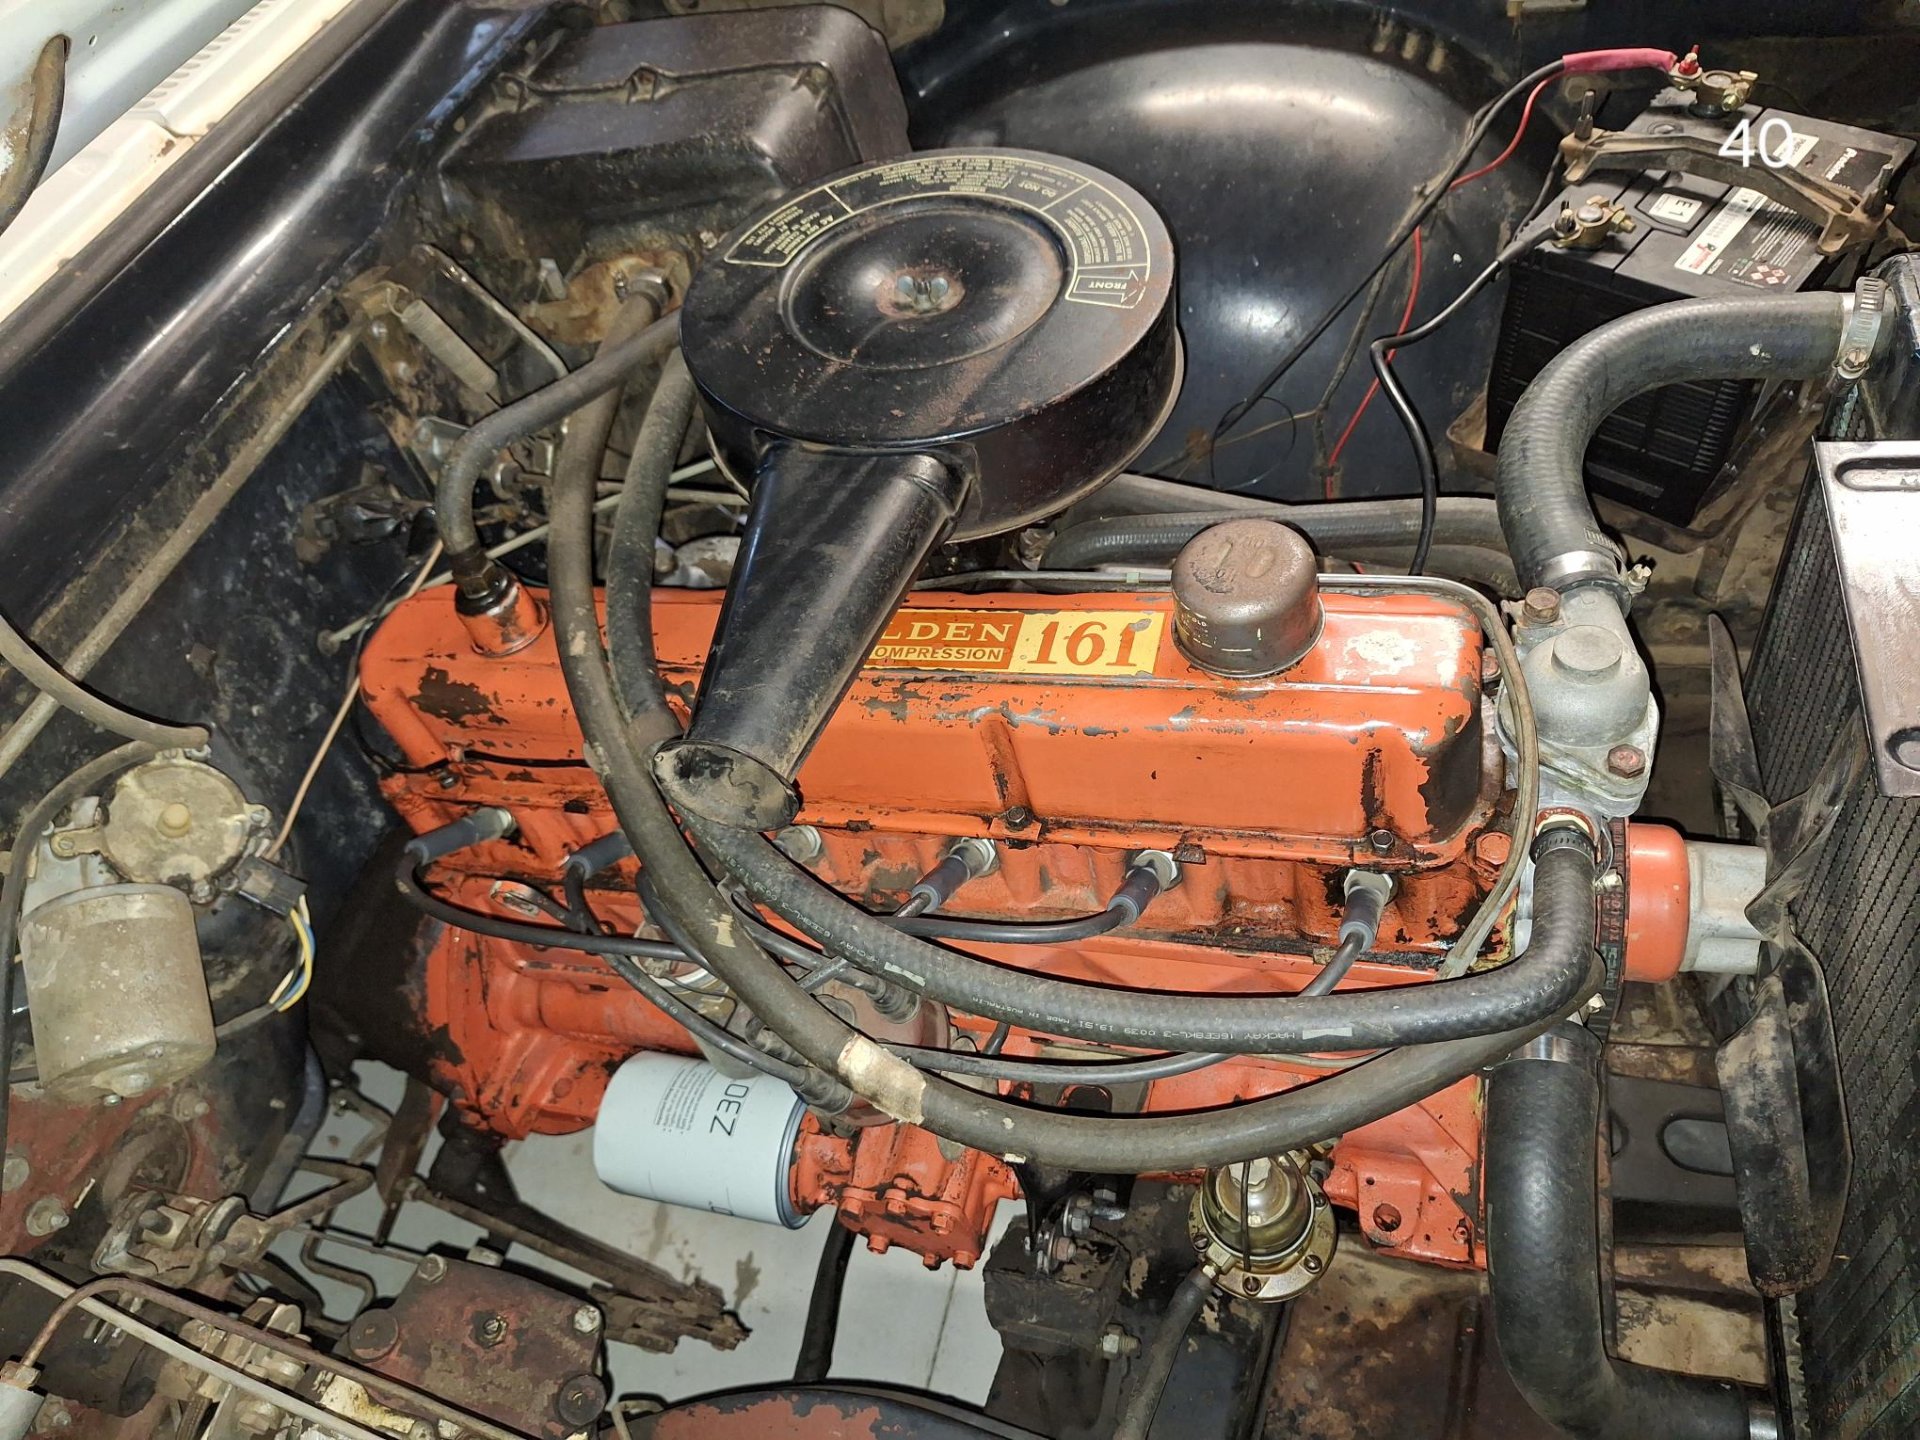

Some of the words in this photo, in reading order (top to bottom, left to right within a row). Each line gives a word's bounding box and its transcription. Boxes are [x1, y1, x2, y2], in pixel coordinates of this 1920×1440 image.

[1088, 281, 1128, 290] FRONT
[881, 621, 1014, 642] LDEN
[1027, 619, 1138, 668] 161
[874, 646, 1001, 661] OMPRESSION
[972, 996, 1027, 1014] AUSTRALIA
[1046, 1015, 1070, 1024] MADE
[1244, 1031, 1295, 1041] MACKAY
[709, 1083, 750, 1137] Z30
